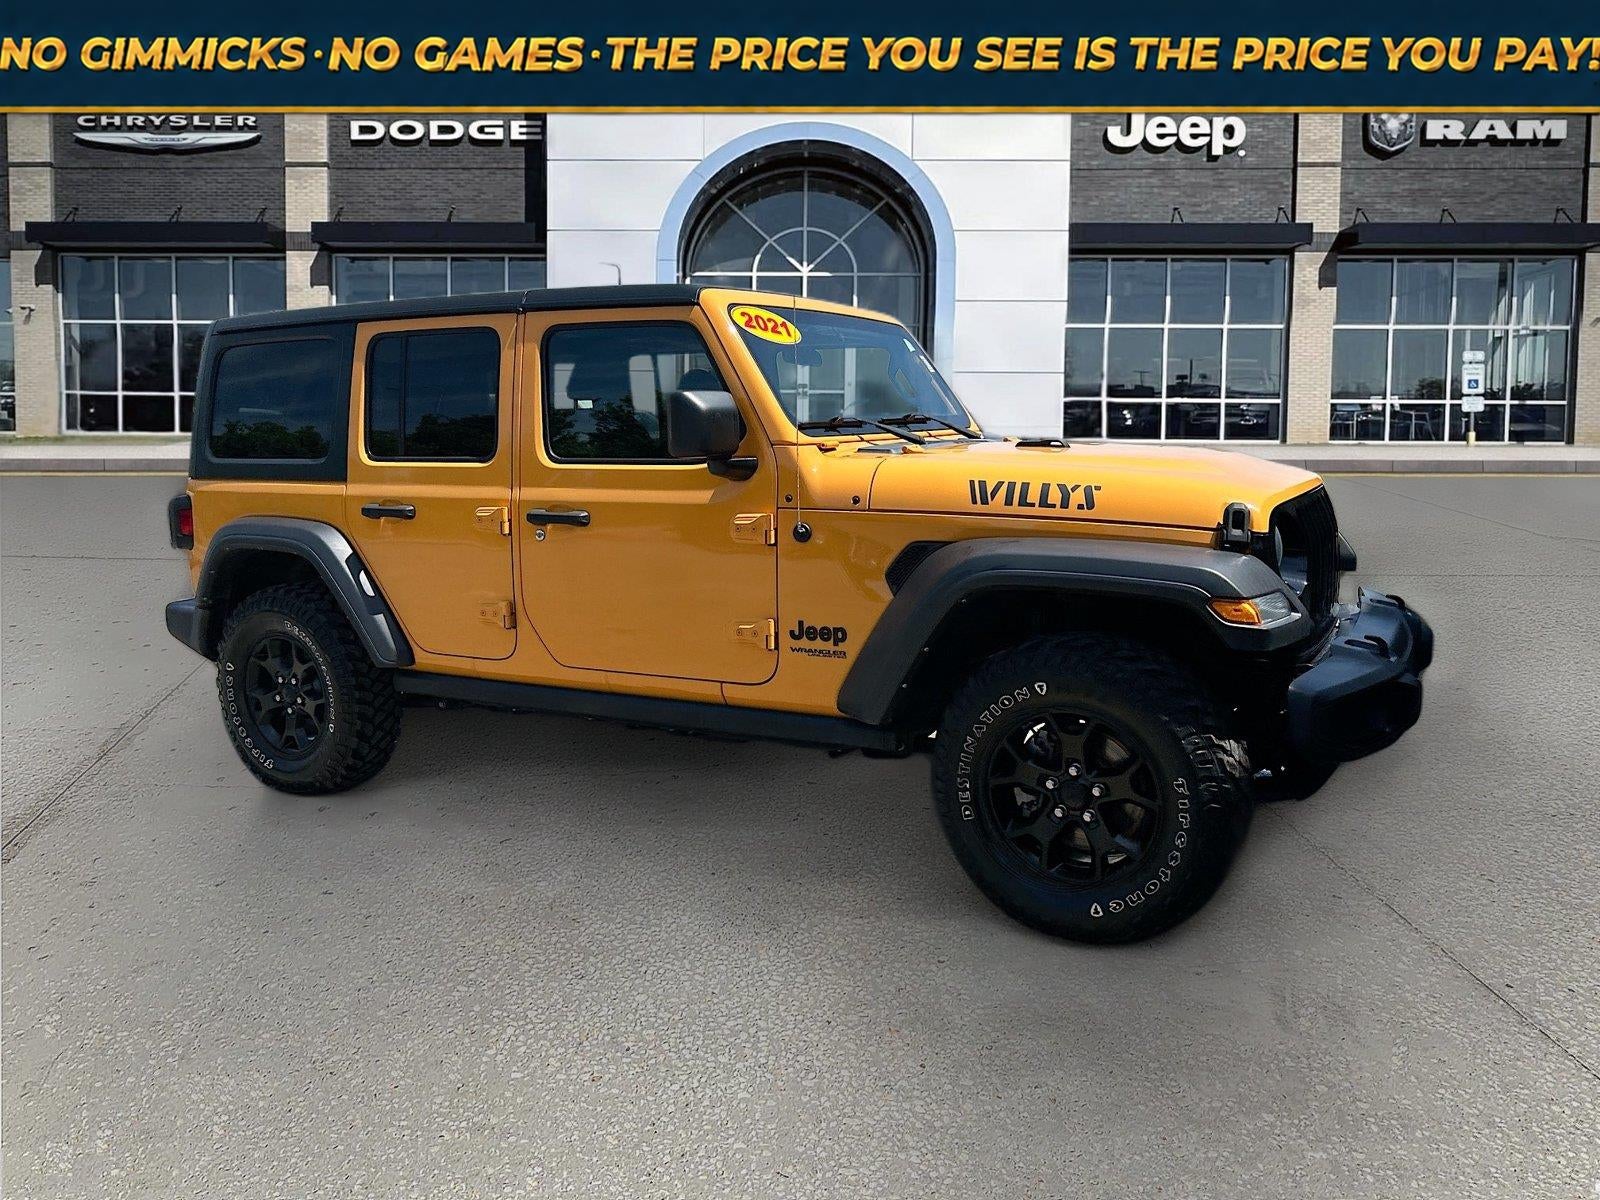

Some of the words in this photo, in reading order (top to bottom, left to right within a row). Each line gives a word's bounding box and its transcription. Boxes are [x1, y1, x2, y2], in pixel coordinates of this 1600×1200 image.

[76, 115, 258, 128] CHRYSLER
[349, 119, 543, 141] DODGE
[1106, 113, 1247, 155] Jeep
[1425, 118, 1568, 141] RAM
[740, 311, 792, 338] 2021
[969, 479, 1101, 510] WILLYS
[789, 620, 848, 646] Jeep
[790, 646, 847, 656] WRANGLER
[956, 686, 1031, 821] DESTINATION
